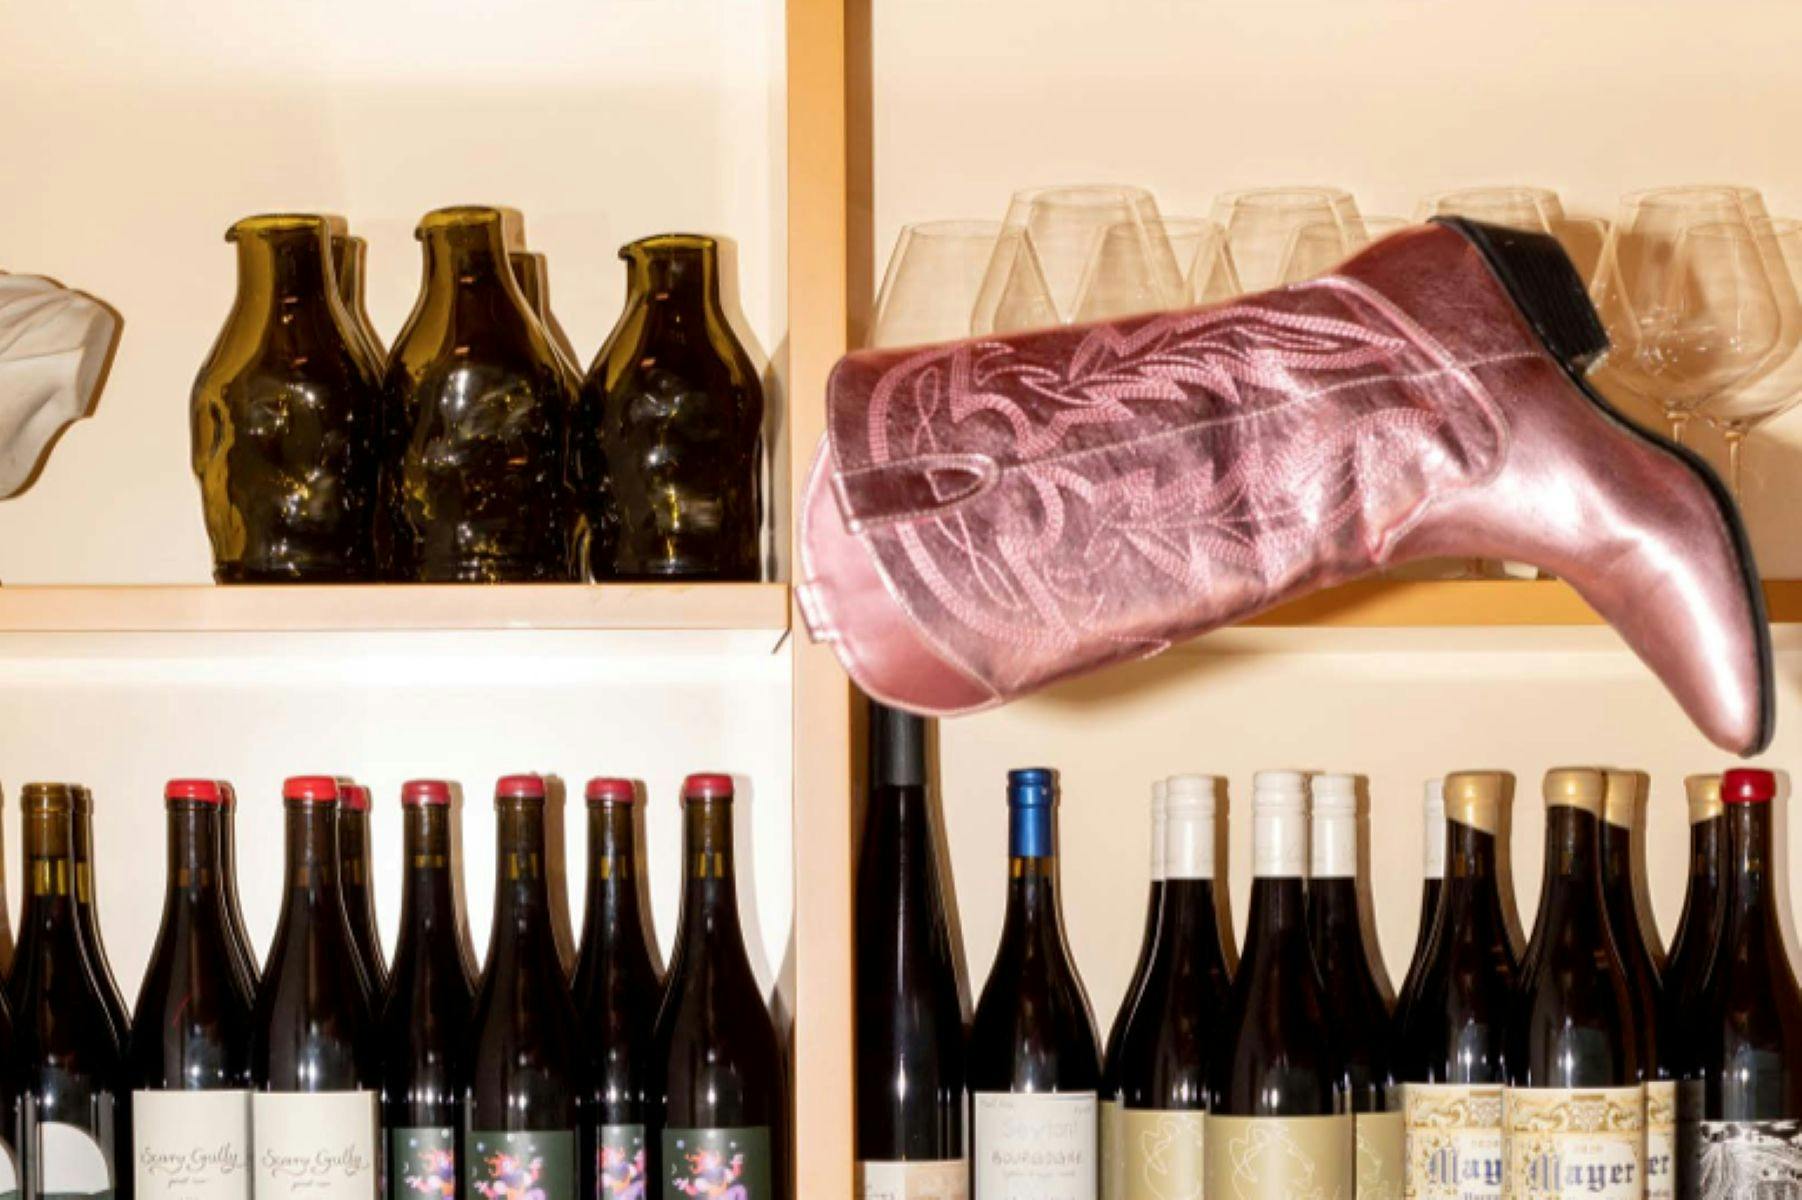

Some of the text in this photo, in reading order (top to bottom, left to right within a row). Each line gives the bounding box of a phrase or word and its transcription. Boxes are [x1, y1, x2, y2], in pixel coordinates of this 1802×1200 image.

[186, 1142, 246, 1174] Gully
[311, 1144, 370, 1177] Gully
[1529, 1153, 1635, 1192] Mayer
